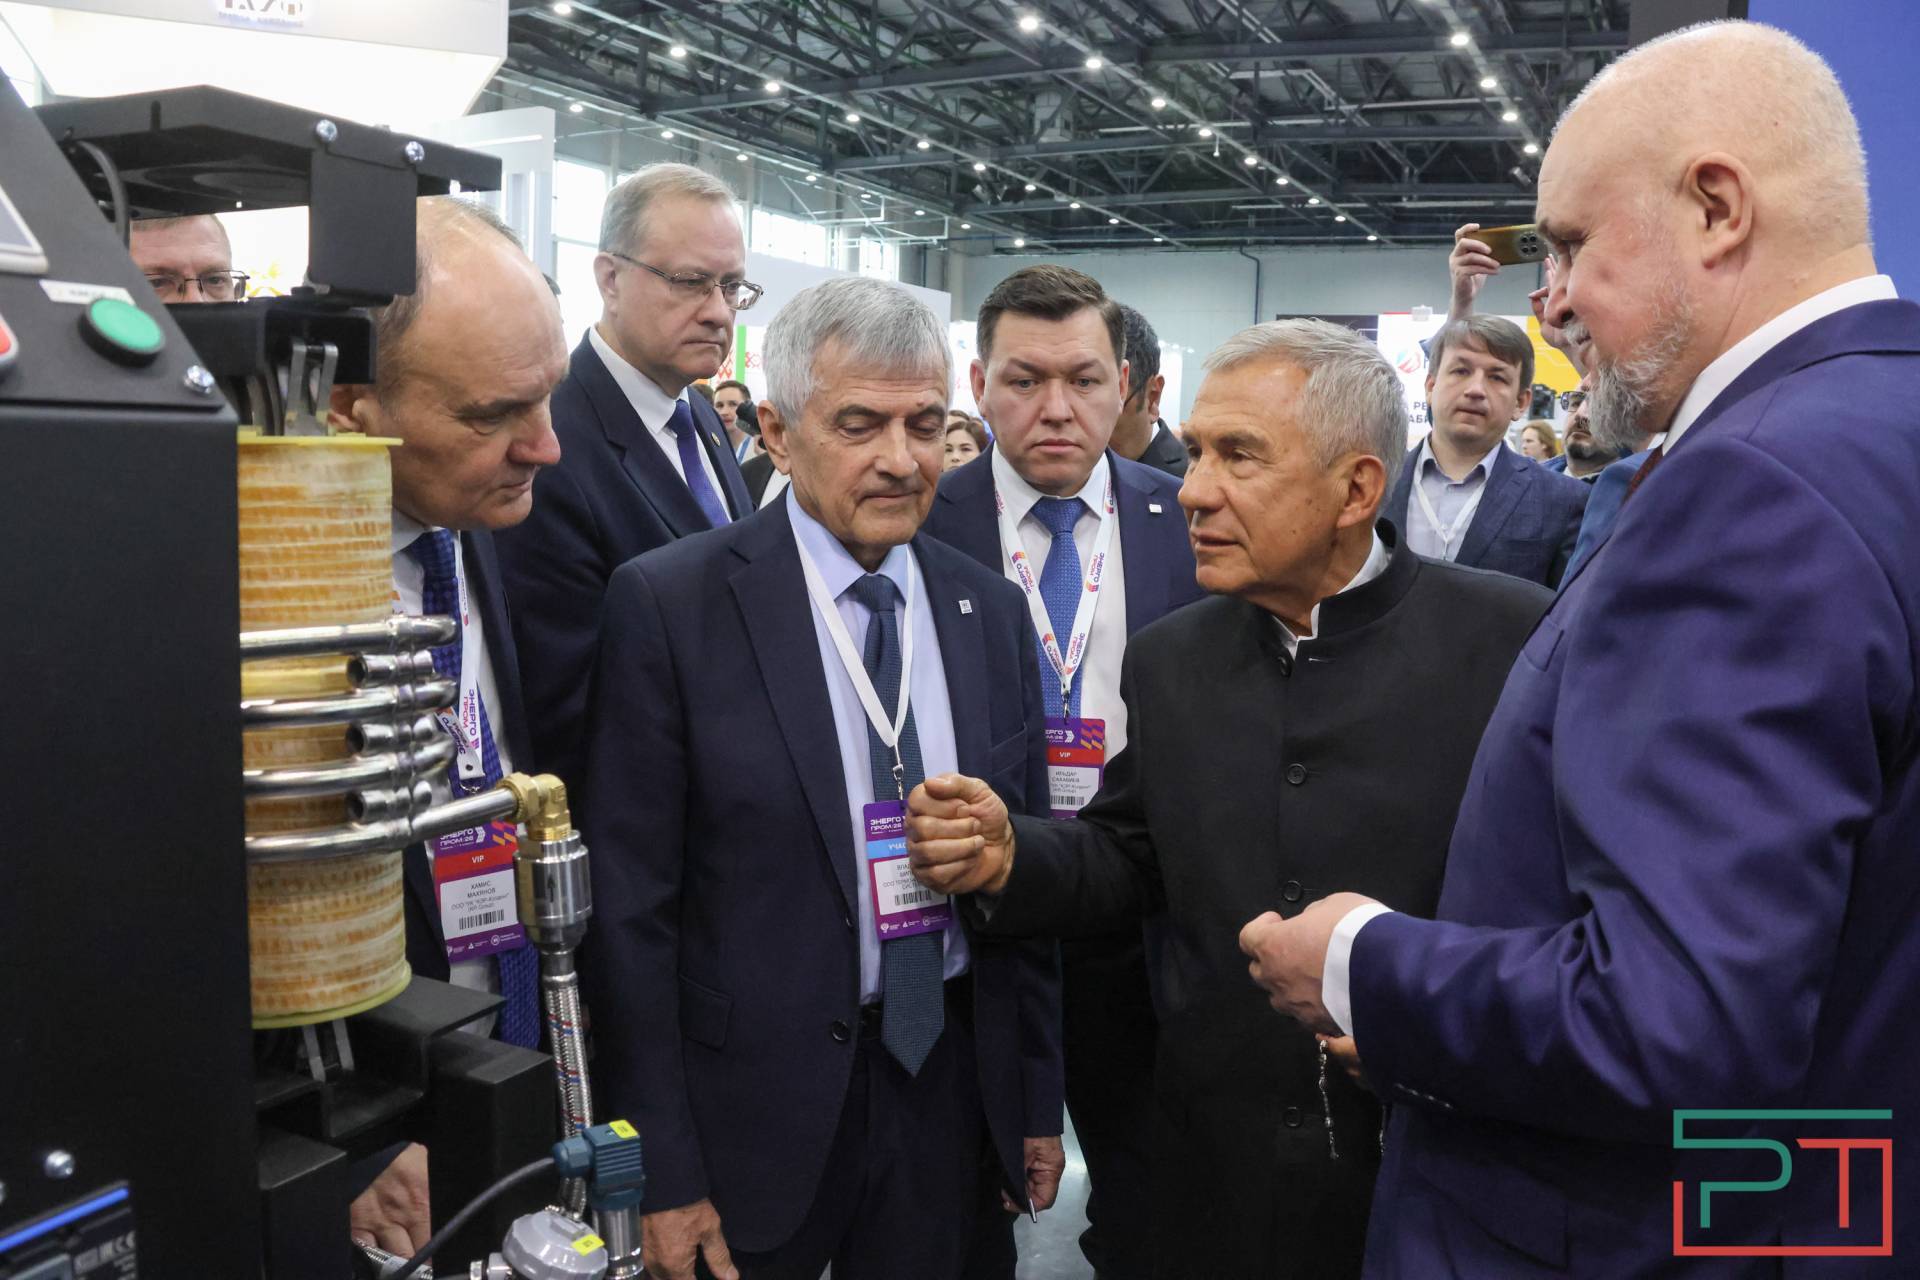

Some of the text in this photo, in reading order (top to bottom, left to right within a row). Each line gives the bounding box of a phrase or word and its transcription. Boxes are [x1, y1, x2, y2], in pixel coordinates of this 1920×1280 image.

[469, 688, 477, 736] ЭНЕРГО
[870, 816, 902, 826] ЭНЕРГО
[471, 855, 485, 864] VIP
[471, 881, 491, 890] ХАМИС
